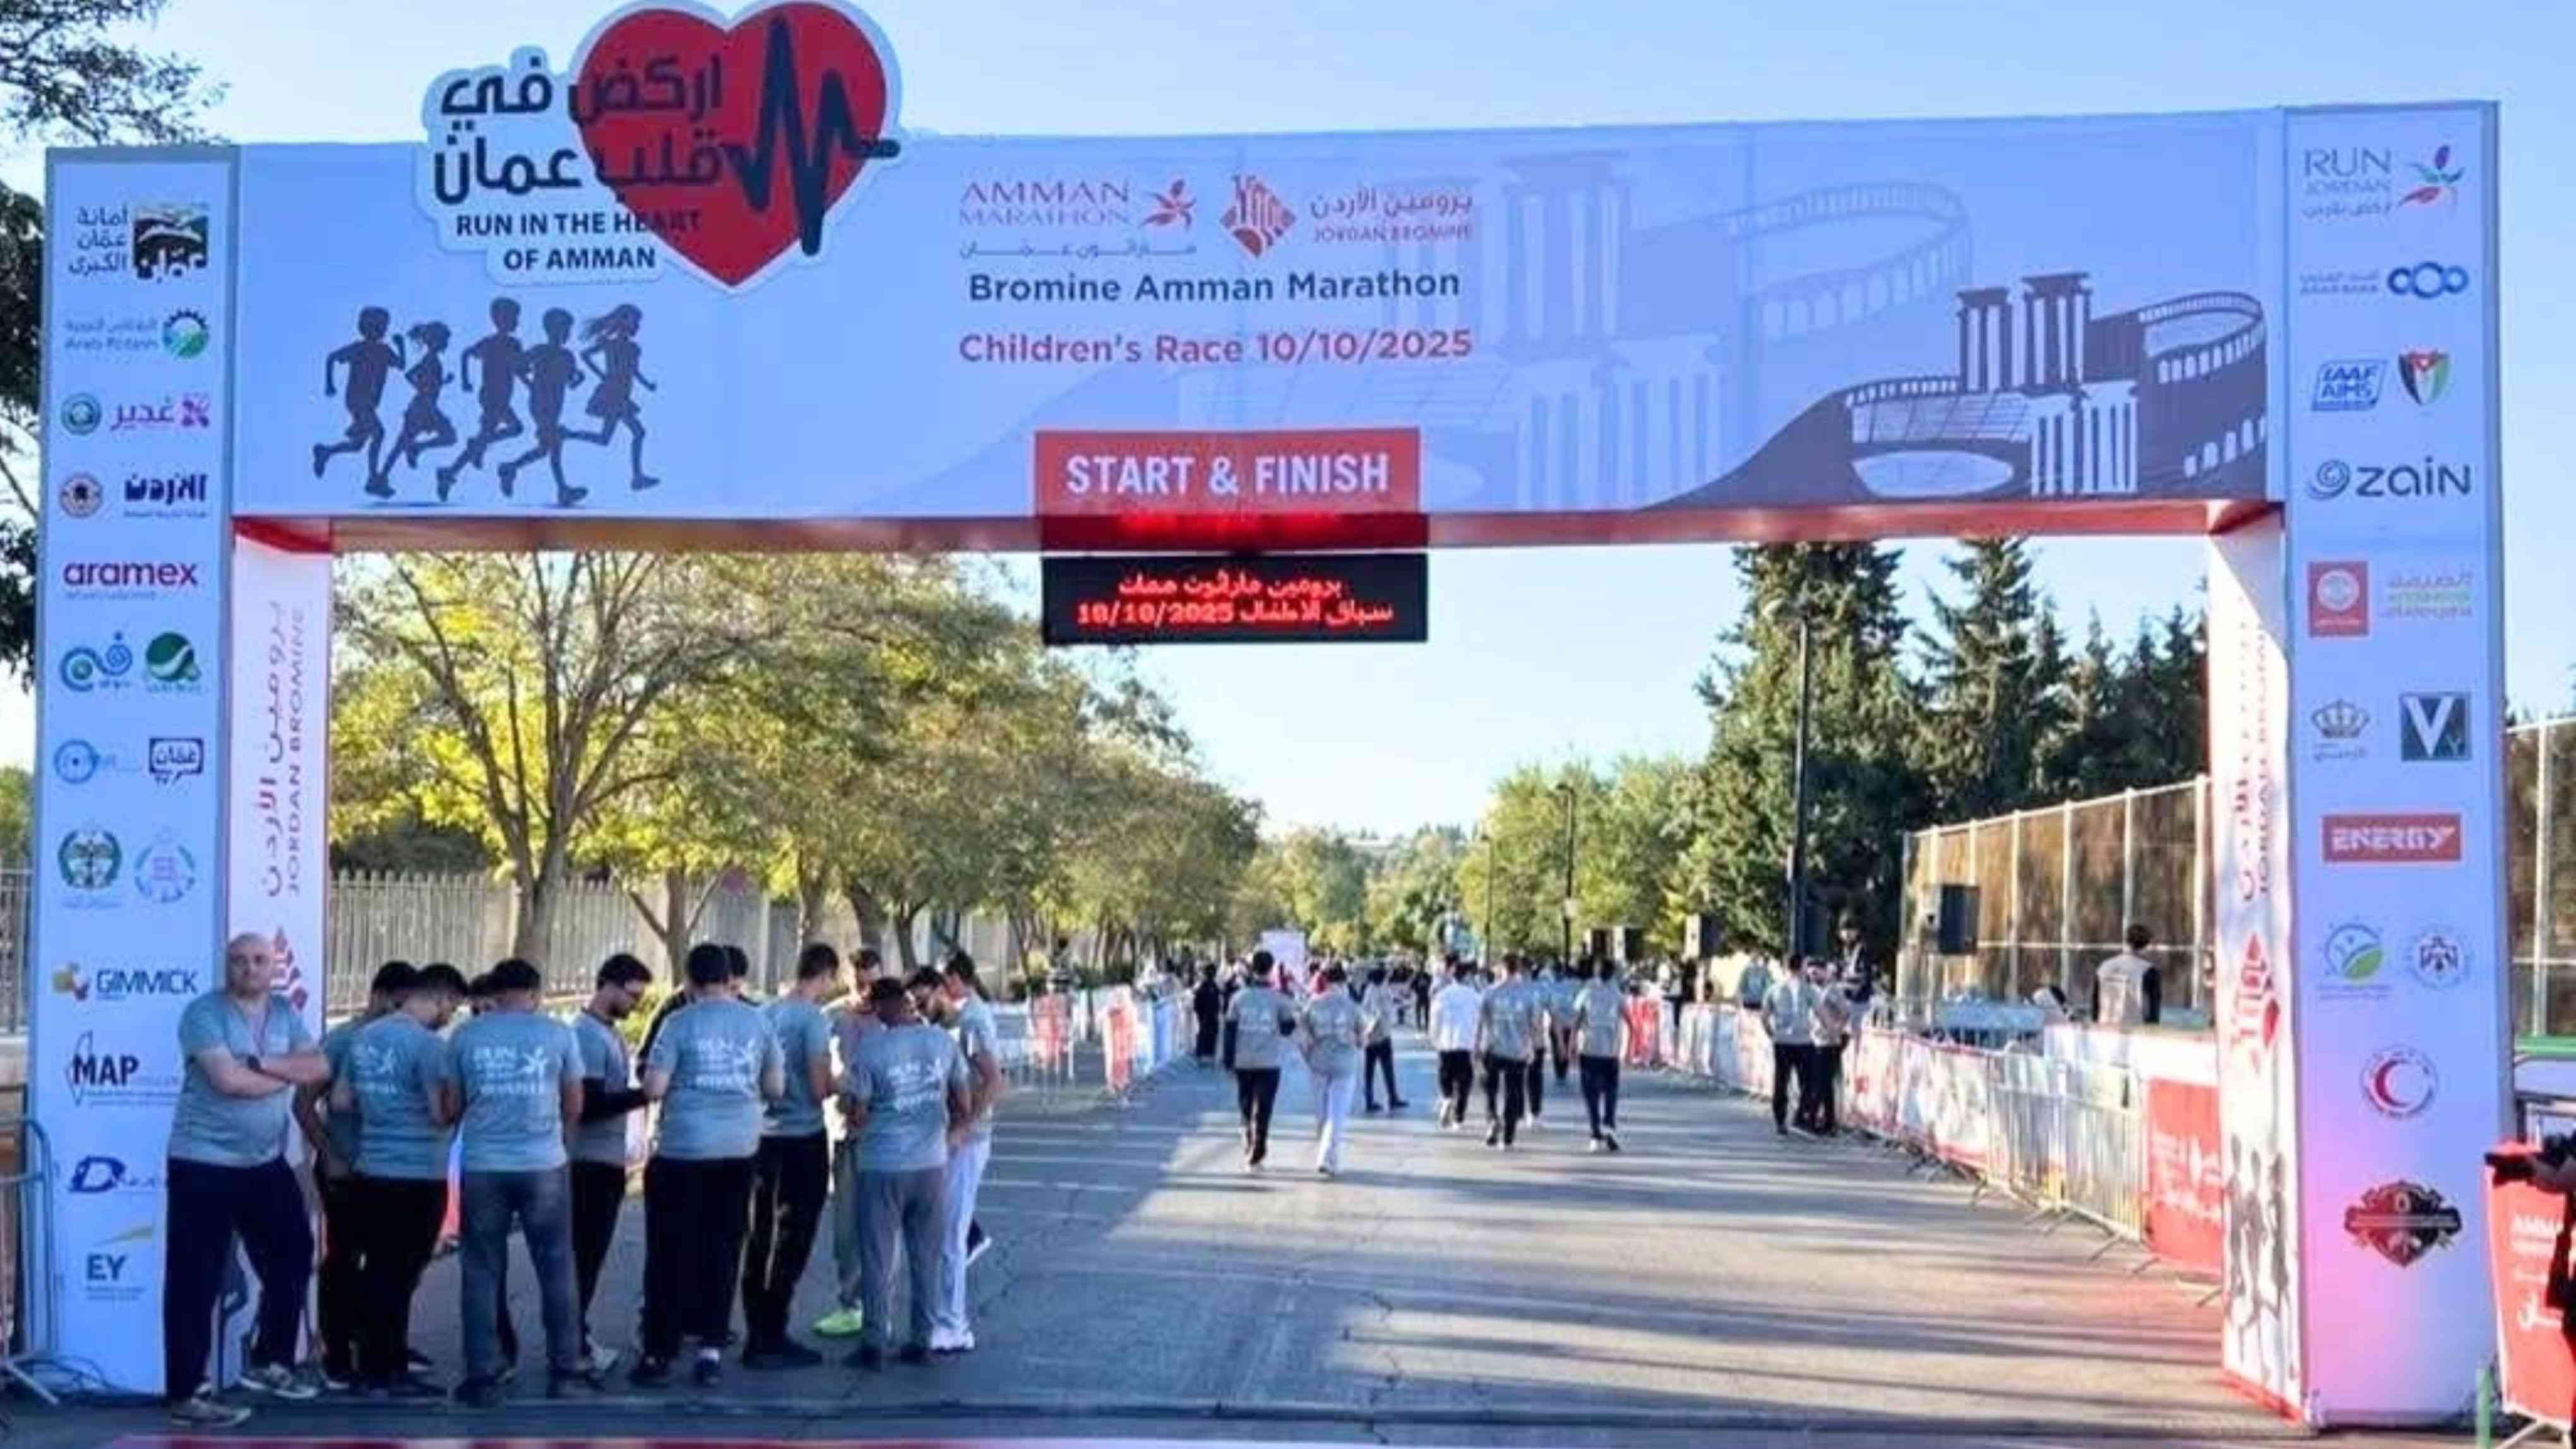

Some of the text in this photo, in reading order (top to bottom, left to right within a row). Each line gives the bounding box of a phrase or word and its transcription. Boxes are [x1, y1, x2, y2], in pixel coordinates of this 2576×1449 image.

[442, 56, 724, 132] اركض في
[434, 126, 724, 205] قلب عمان
[2305, 147, 2392, 177] RUN
[960, 180, 1131, 204] AMMAN
[456, 212, 700, 236] RUN IN THE HEART
[960, 207, 1133, 227] MARATHON
[1315, 225, 1386, 242] JORDAN
[504, 248, 655, 270] OF AMMAN
[970, 269, 1460, 302] Bromine Amman Marathon
[960, 328, 1473, 365] Children's Race 10/10/2025
[1066, 453, 1389, 495] START & FINISH
[63, 562, 197, 587] aramex
[1078, 600, 1233, 628] 10/10/2025
[288, 607, 306, 897] JORDAN BROMINE
[2331, 826, 2455, 851] ENERGY
[97, 969, 199, 994] GIMMICK
[72, 1054, 140, 1086] MAP
[86, 1254, 128, 1281] EY
